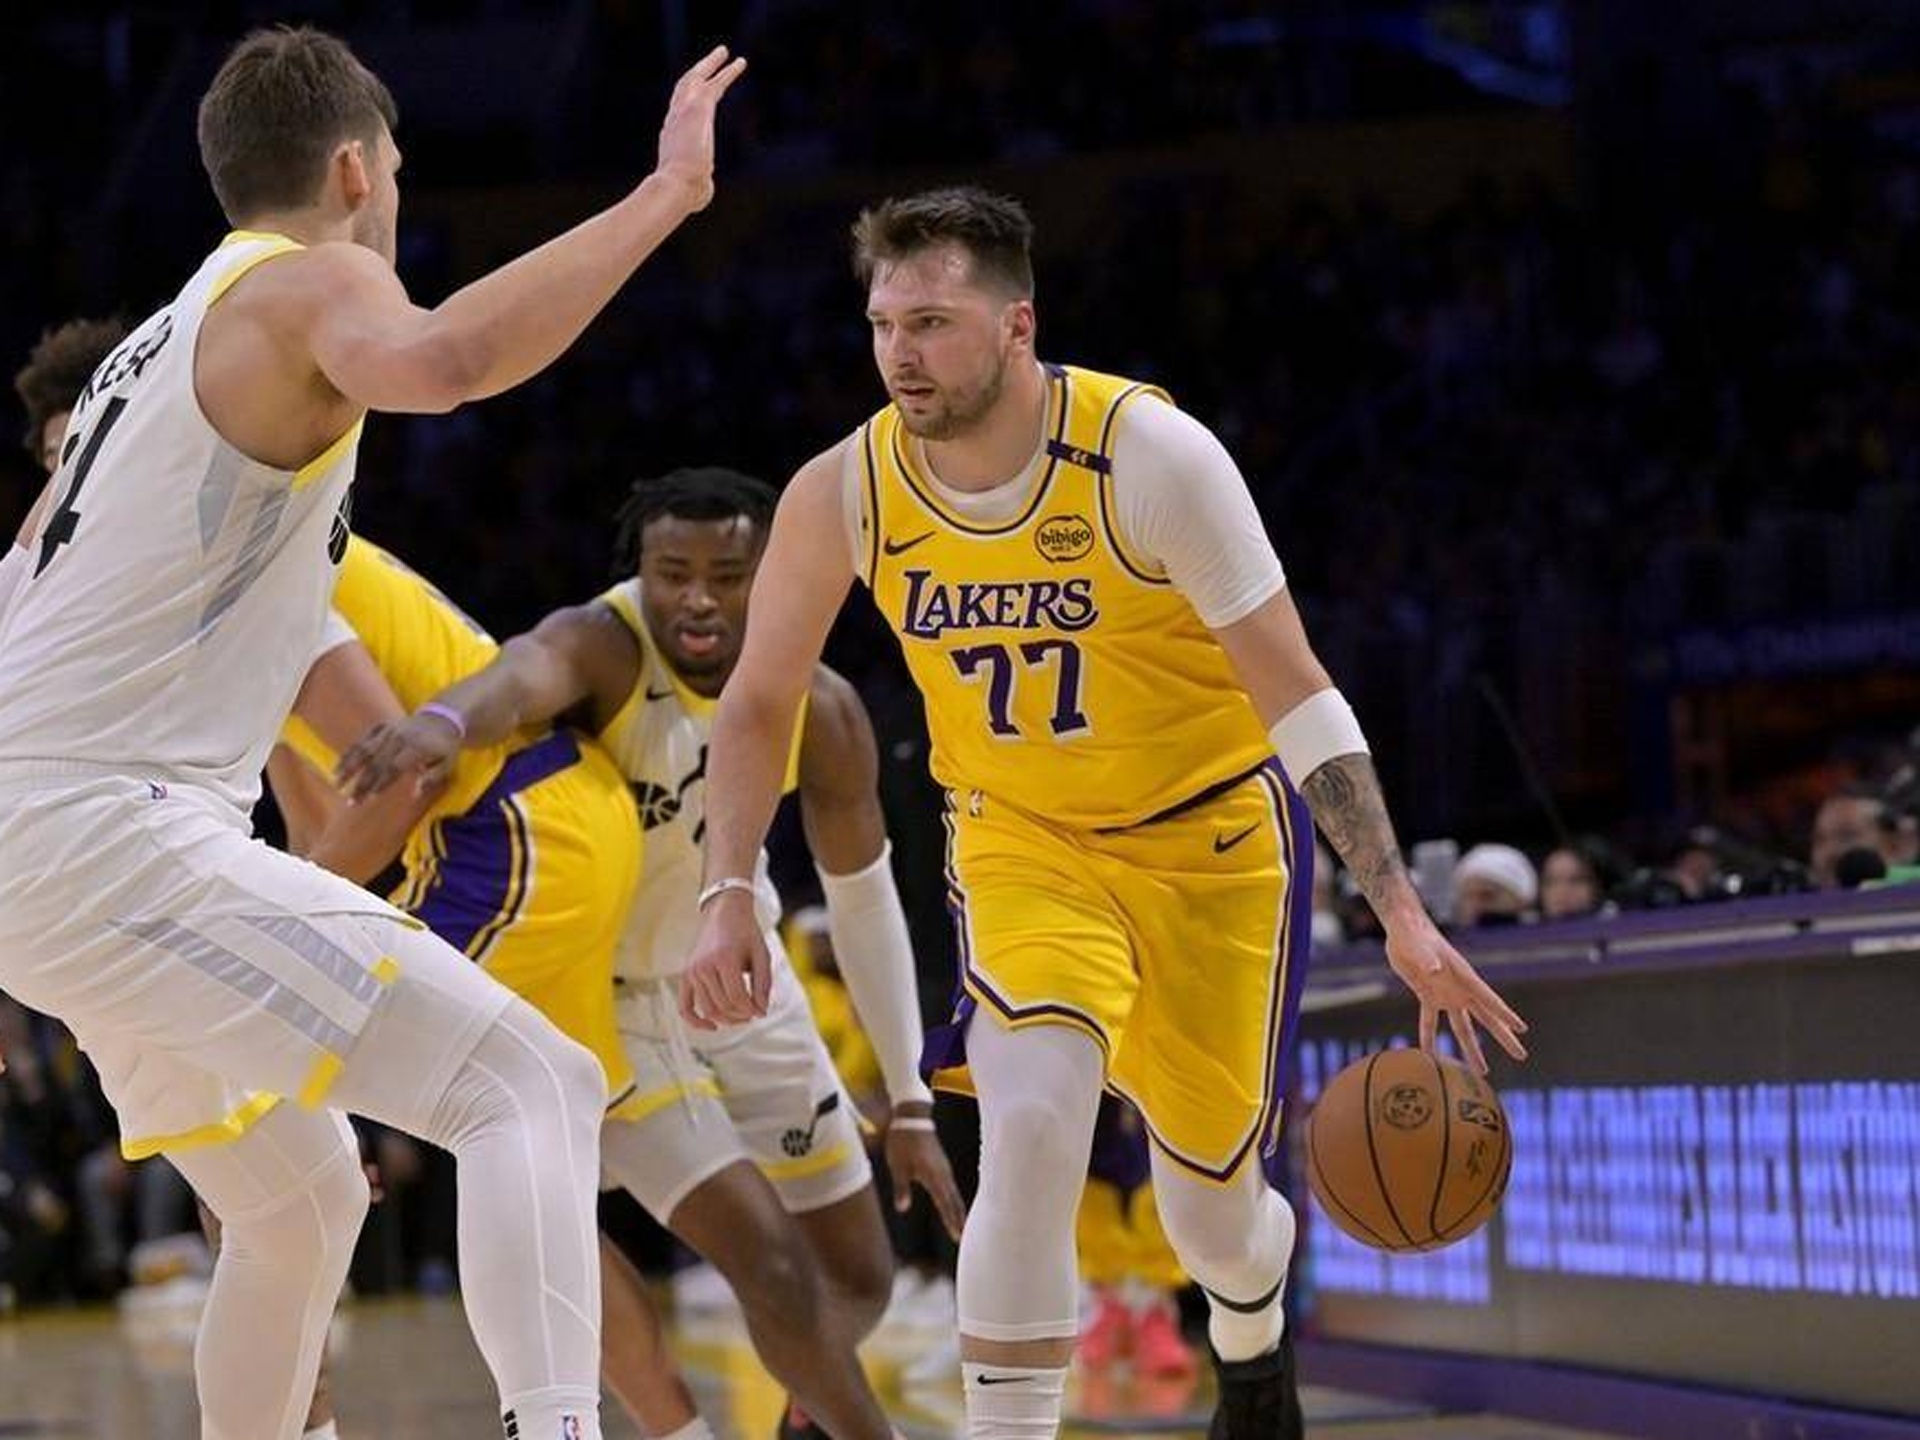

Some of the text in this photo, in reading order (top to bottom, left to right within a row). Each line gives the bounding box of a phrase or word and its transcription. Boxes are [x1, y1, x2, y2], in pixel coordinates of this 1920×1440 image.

[1040, 527, 1091, 547] bibigo
[902, 569, 1099, 639] LAKERS
[950, 639, 1088, 735] 77
